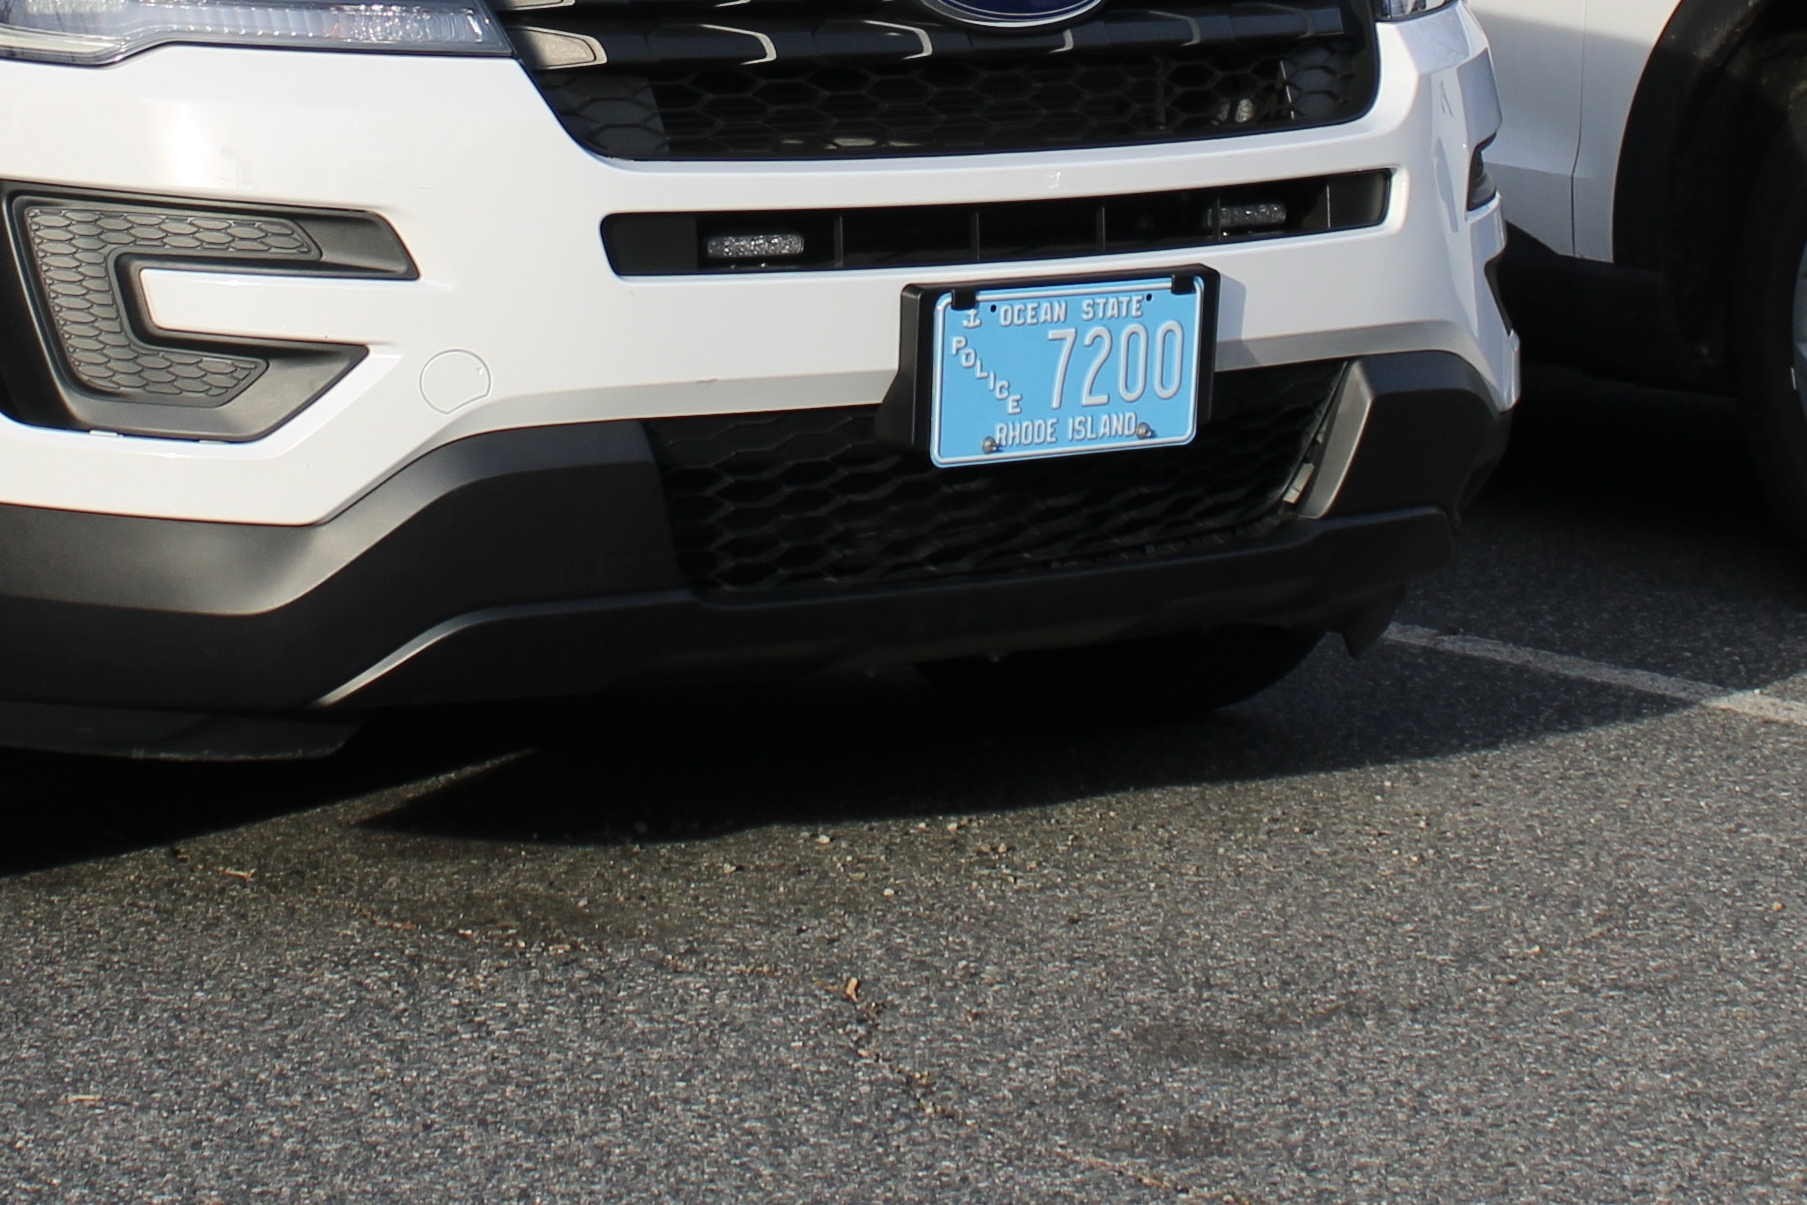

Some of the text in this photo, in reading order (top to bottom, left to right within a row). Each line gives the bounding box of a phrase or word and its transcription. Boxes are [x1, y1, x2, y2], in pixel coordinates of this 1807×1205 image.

[999, 295, 1144, 327] OCEAN STATE
[951, 335, 1023, 415] POLICE
[1047, 319, 1185, 410] 7200
[994, 411, 1138, 448] RHODE ISLAND
